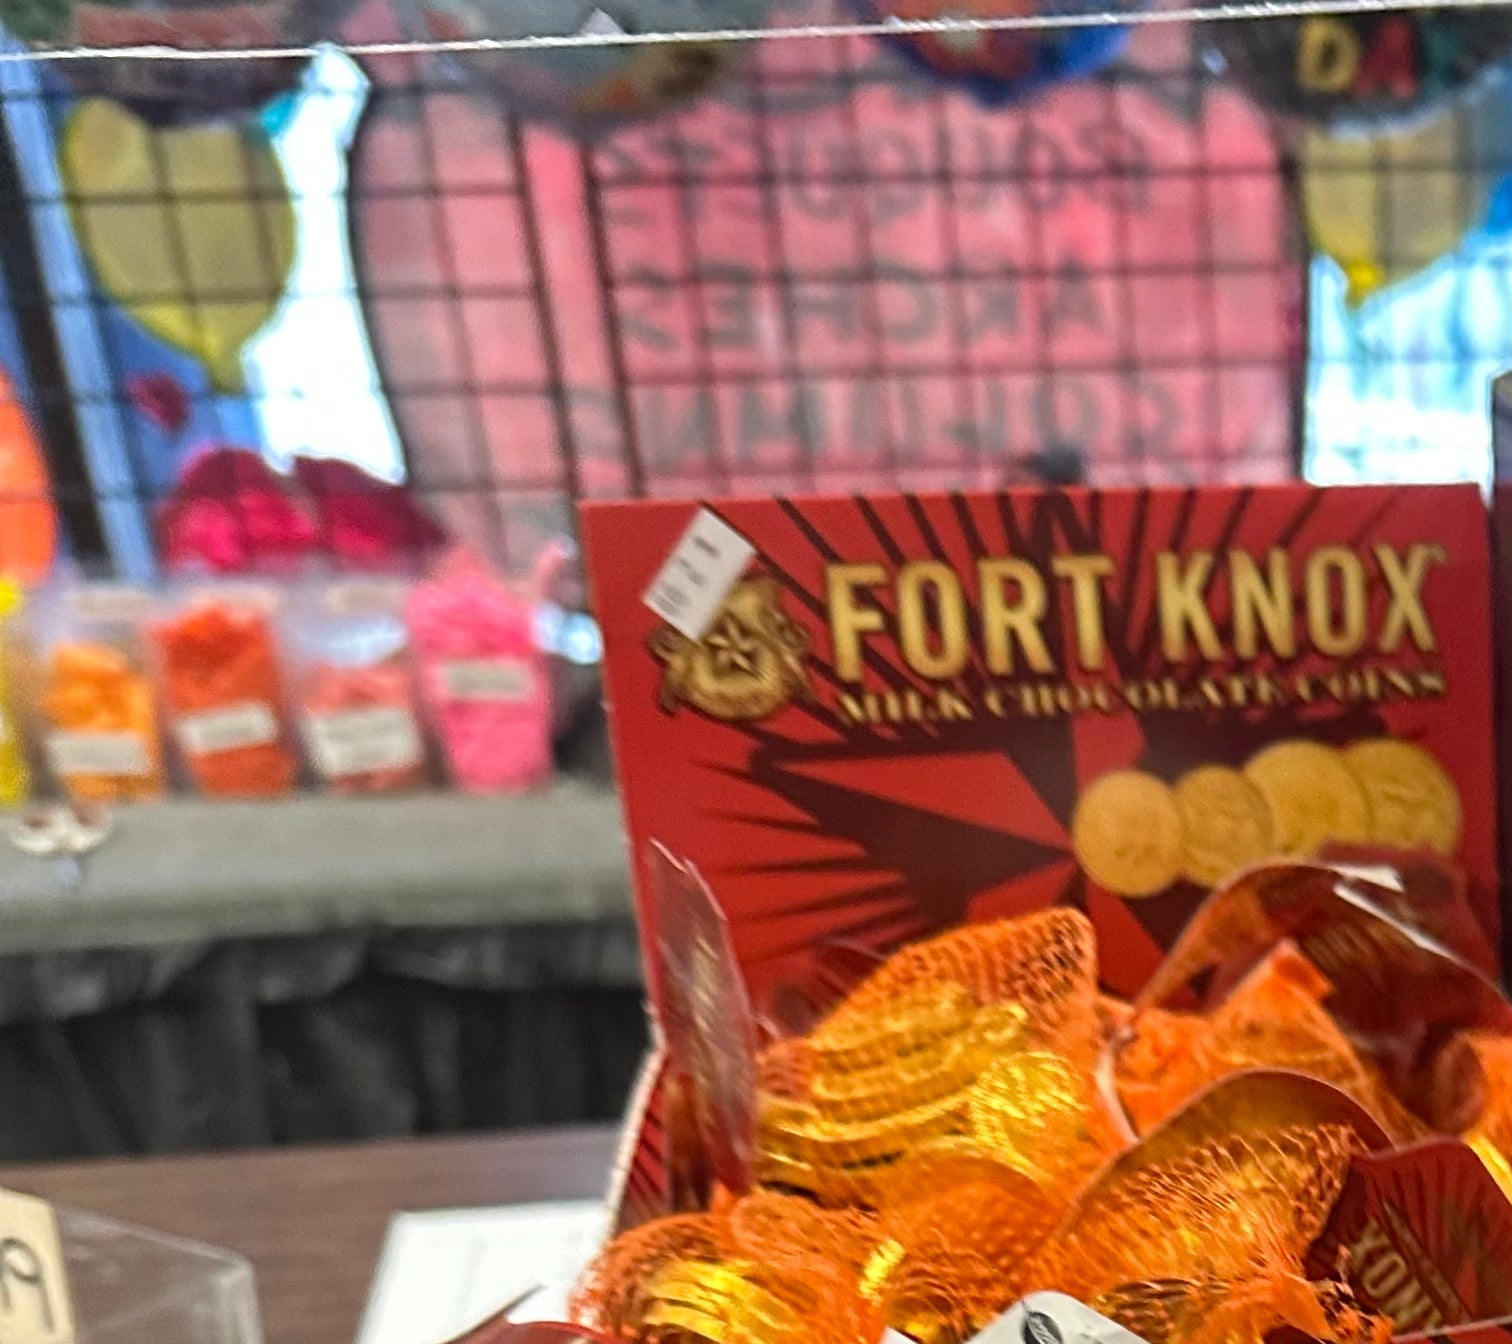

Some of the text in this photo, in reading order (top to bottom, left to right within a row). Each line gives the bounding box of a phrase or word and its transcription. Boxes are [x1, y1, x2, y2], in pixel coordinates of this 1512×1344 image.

[823, 556, 1115, 682] FORT
[1155, 544, 1438, 663] KNOX
[837, 668, 1446, 723] MILK CHOCOLATE COINS
